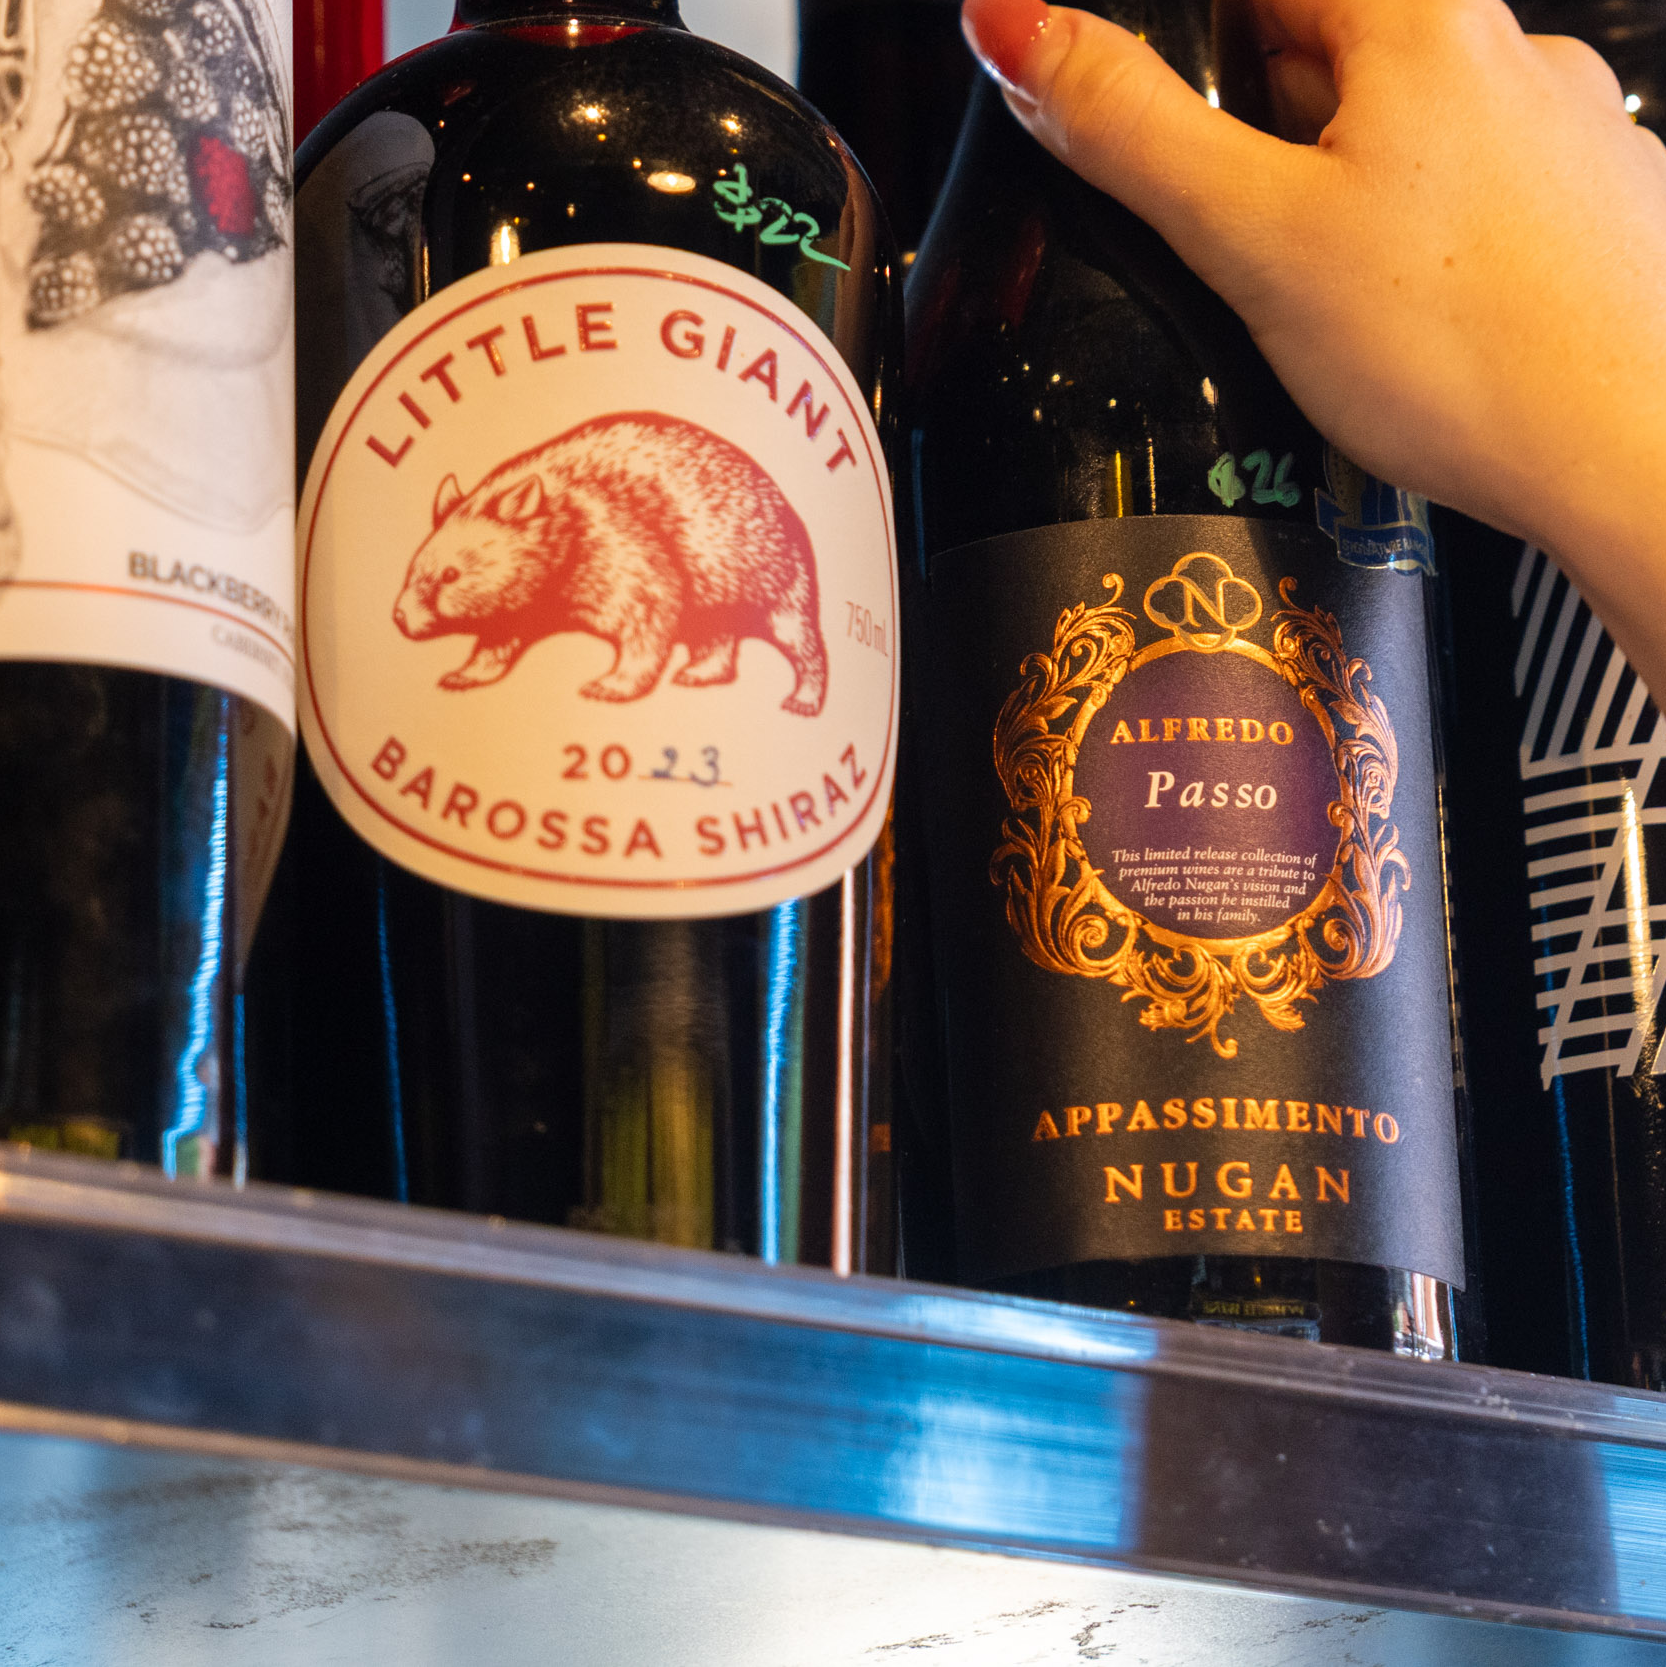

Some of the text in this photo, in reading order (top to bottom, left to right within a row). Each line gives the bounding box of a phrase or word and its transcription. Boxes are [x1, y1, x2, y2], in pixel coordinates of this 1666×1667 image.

[713, 162, 852, 271] $22
[364, 302, 859, 473] LITTLE GIANT
[128, 550, 282, 626] BLACKBERRY
[1110, 717, 1294, 745] ALFREDO
[369, 736, 869, 862] BAROSSA SHIRAZ
[1144, 770, 1278, 810] Passo
[1112, 847, 1318, 868] This limited release collection of
[1119, 865, 1316, 882] premium wines are a tribute to
[1131, 877, 1307, 896] Alfredo Nugan's vision and
[1144, 894, 1290, 910] the passion he instilled
[1177, 908, 1262, 925] in his family.
[1032, 1097, 1400, 1145] APPASSIMENTO
[1103, 1161, 1351, 1204] NUGAN
[1163, 1207, 1303, 1233] ESTATE
